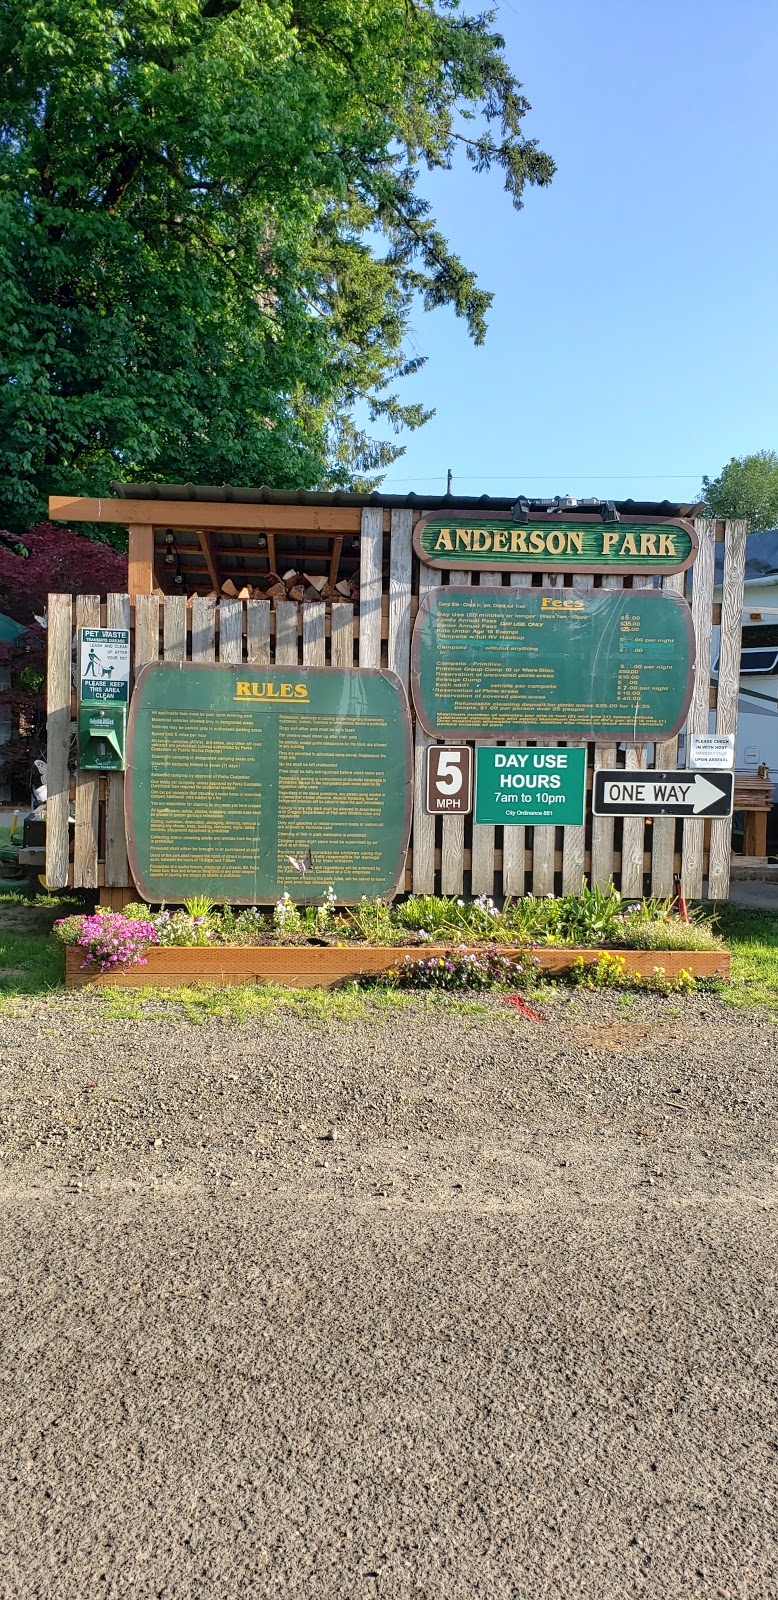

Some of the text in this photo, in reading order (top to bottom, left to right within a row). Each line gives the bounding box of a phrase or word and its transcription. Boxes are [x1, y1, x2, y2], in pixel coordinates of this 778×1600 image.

[434, 529, 677, 556] ANDERSON PARK
[541, 598, 584, 608] Fees
[236, 681, 308, 698] RULES
[495, 754, 567, 768] DAY USE
[435, 751, 462, 795] 5
[500, 774, 561, 788] HOURS
[494, 793, 565, 805] 7am to 10pm
[609, 785, 692, 802] ONE WAY
[436, 799, 460, 808] MPH
